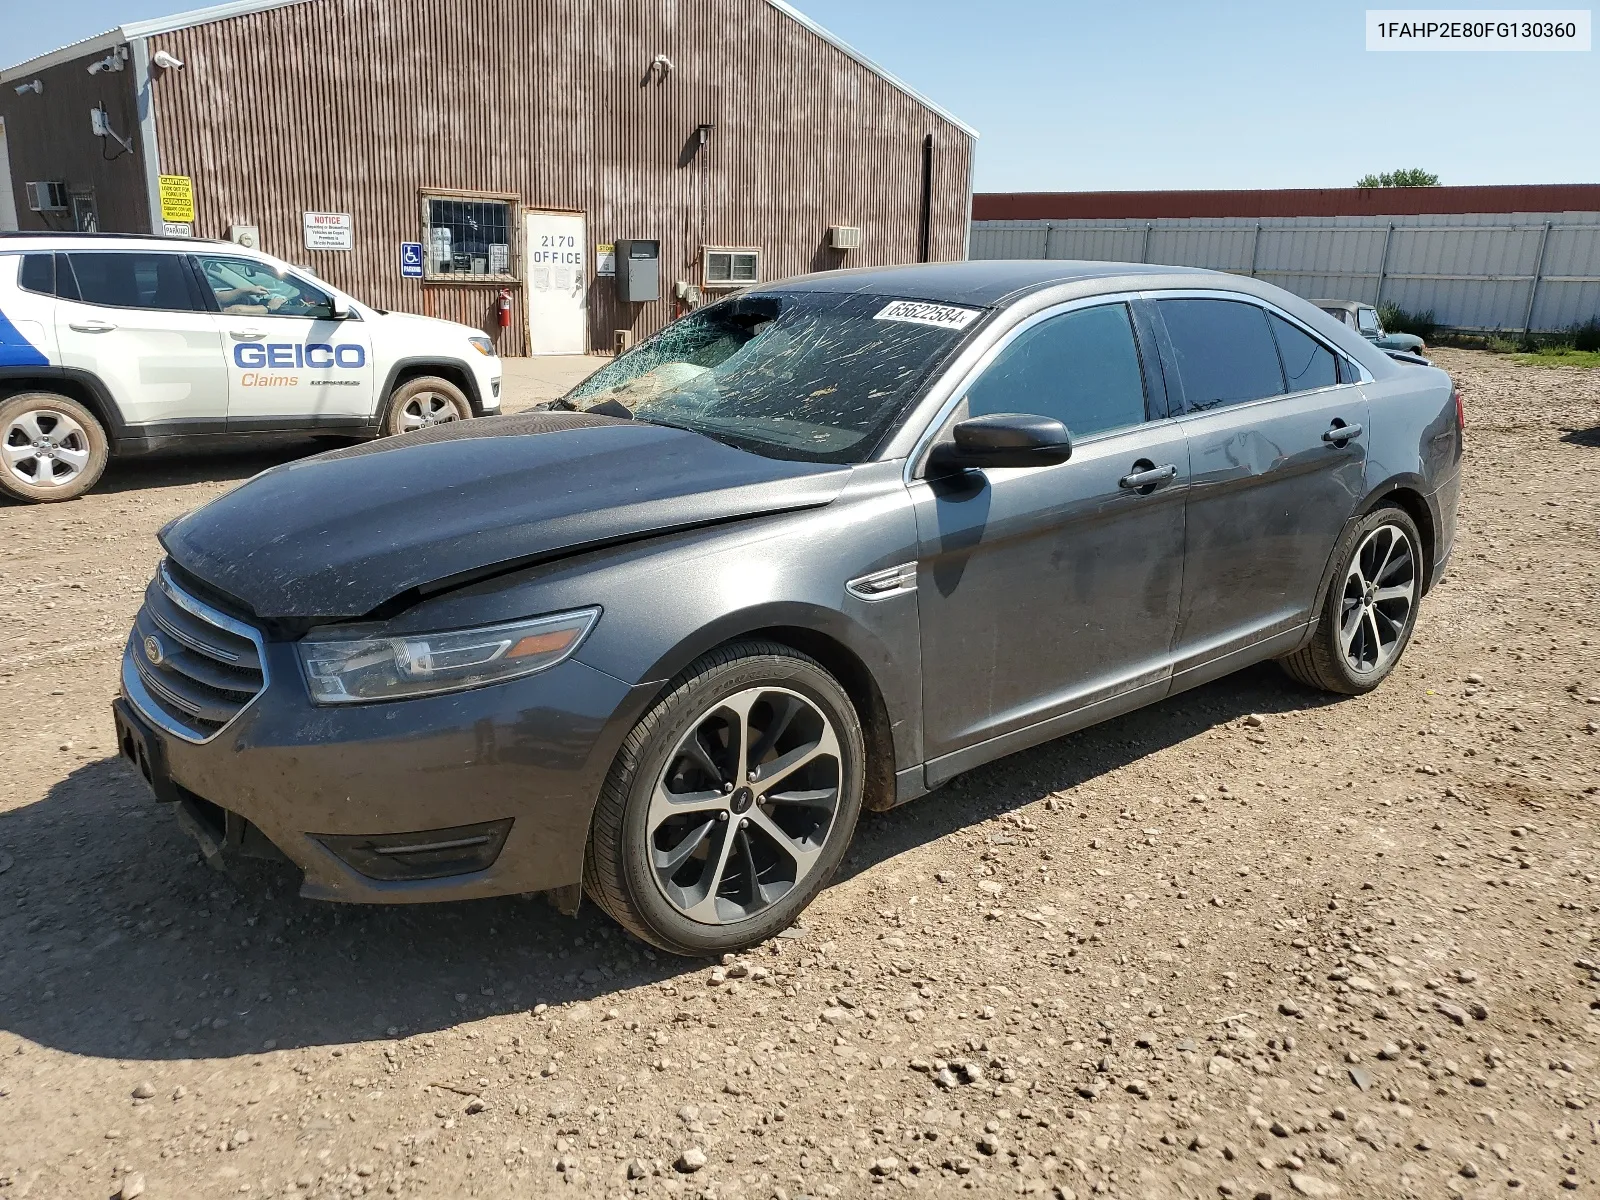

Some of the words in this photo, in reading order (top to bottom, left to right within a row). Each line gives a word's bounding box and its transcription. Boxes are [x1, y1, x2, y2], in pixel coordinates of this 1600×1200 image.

[161, 178, 189, 186] CAUTION
[314, 216, 341, 225] NOTICE
[541, 235, 574, 247] 2170
[534, 251, 581, 264] OFFICE
[888, 303, 964, 323] 65622584
[233, 343, 365, 369] GEICO
[241, 373, 299, 387] Claims
